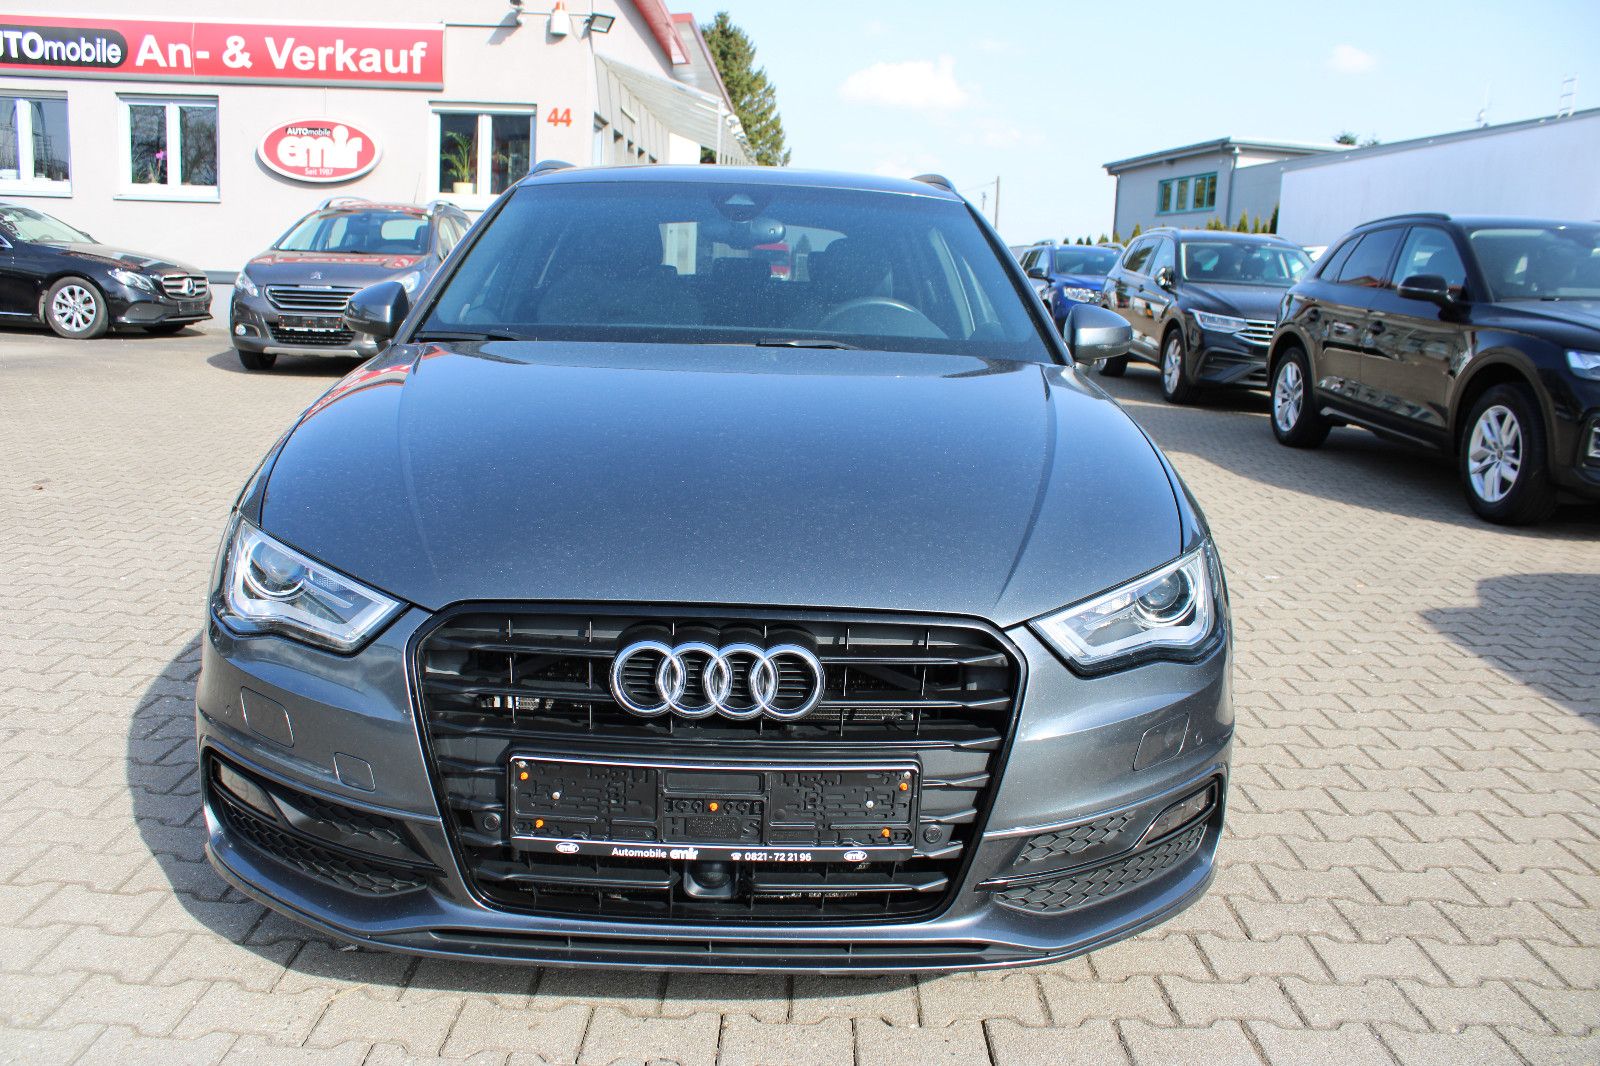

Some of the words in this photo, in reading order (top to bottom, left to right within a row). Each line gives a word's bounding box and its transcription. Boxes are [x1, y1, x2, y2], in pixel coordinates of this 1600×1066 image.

[0, 30, 122, 64] TOmobile
[135, 34, 209, 68] An-
[222, 35, 253, 69] &
[264, 37, 428, 74] Verkauf
[547, 107, 572, 127] 44
[286, 127, 331, 137] AUTOmobile
[277, 125, 362, 168] emir
[304, 168, 318, 176] Seit
[319, 168, 334, 176] 1987
[611, 847, 668, 859] Automobile
[669, 847, 699, 860] emir
[744, 852, 768, 861] 0821
